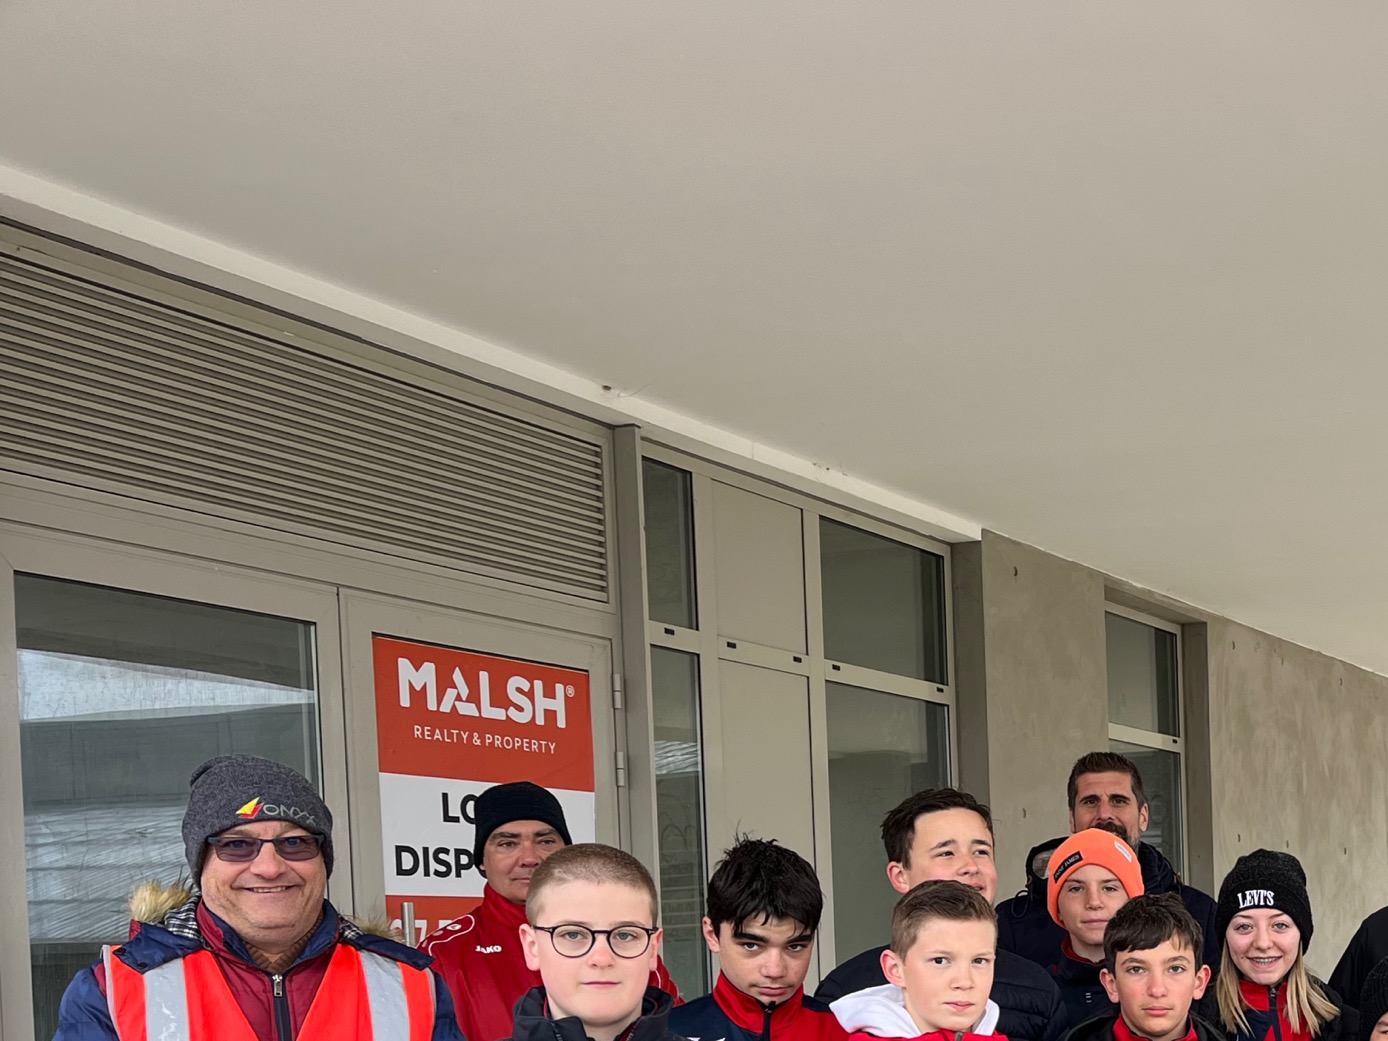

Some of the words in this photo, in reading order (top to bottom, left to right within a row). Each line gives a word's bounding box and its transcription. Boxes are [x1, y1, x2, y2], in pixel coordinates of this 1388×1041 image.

[414, 725, 469, 745] REALTY
[472, 732, 482, 746] &
[485, 734, 557, 754] PROPERTY
